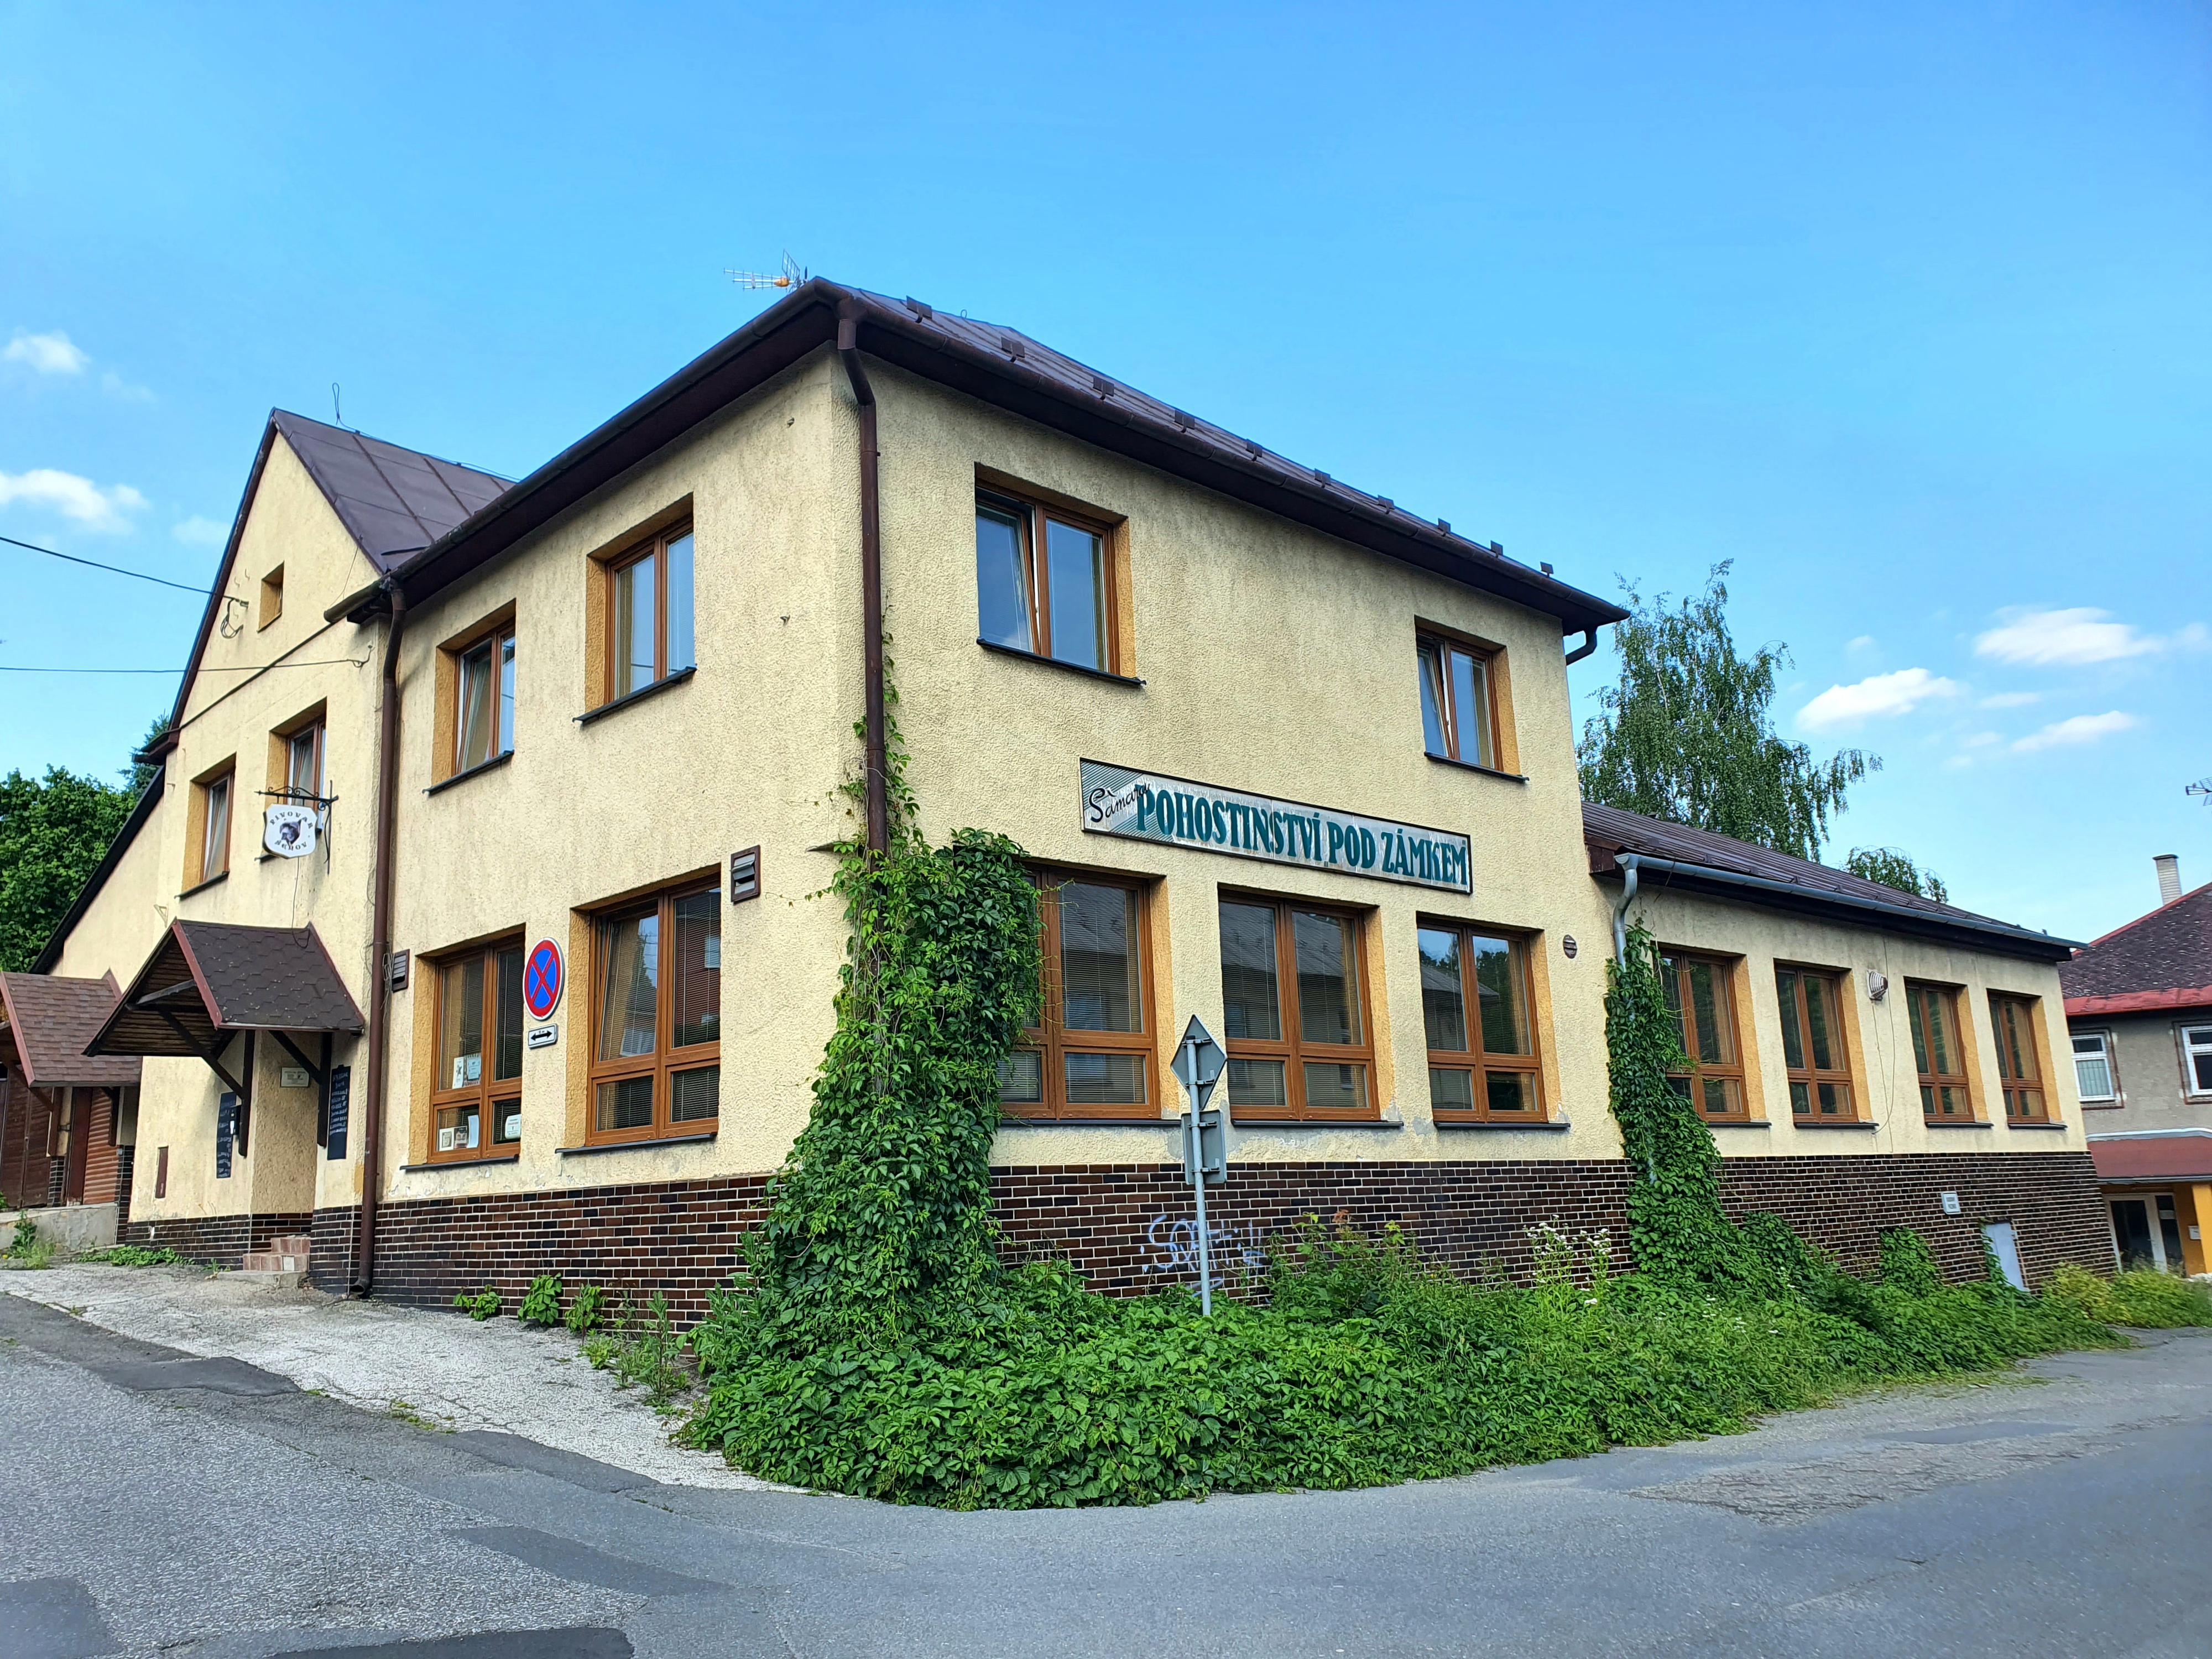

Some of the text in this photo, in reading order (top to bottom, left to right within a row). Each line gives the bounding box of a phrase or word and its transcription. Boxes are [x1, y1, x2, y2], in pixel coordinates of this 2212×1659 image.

[270, 811, 313, 829] PIVOVAR
[1135, 784, 1468, 885] POHOSTINSTVÍ POD ZÁMKEM
